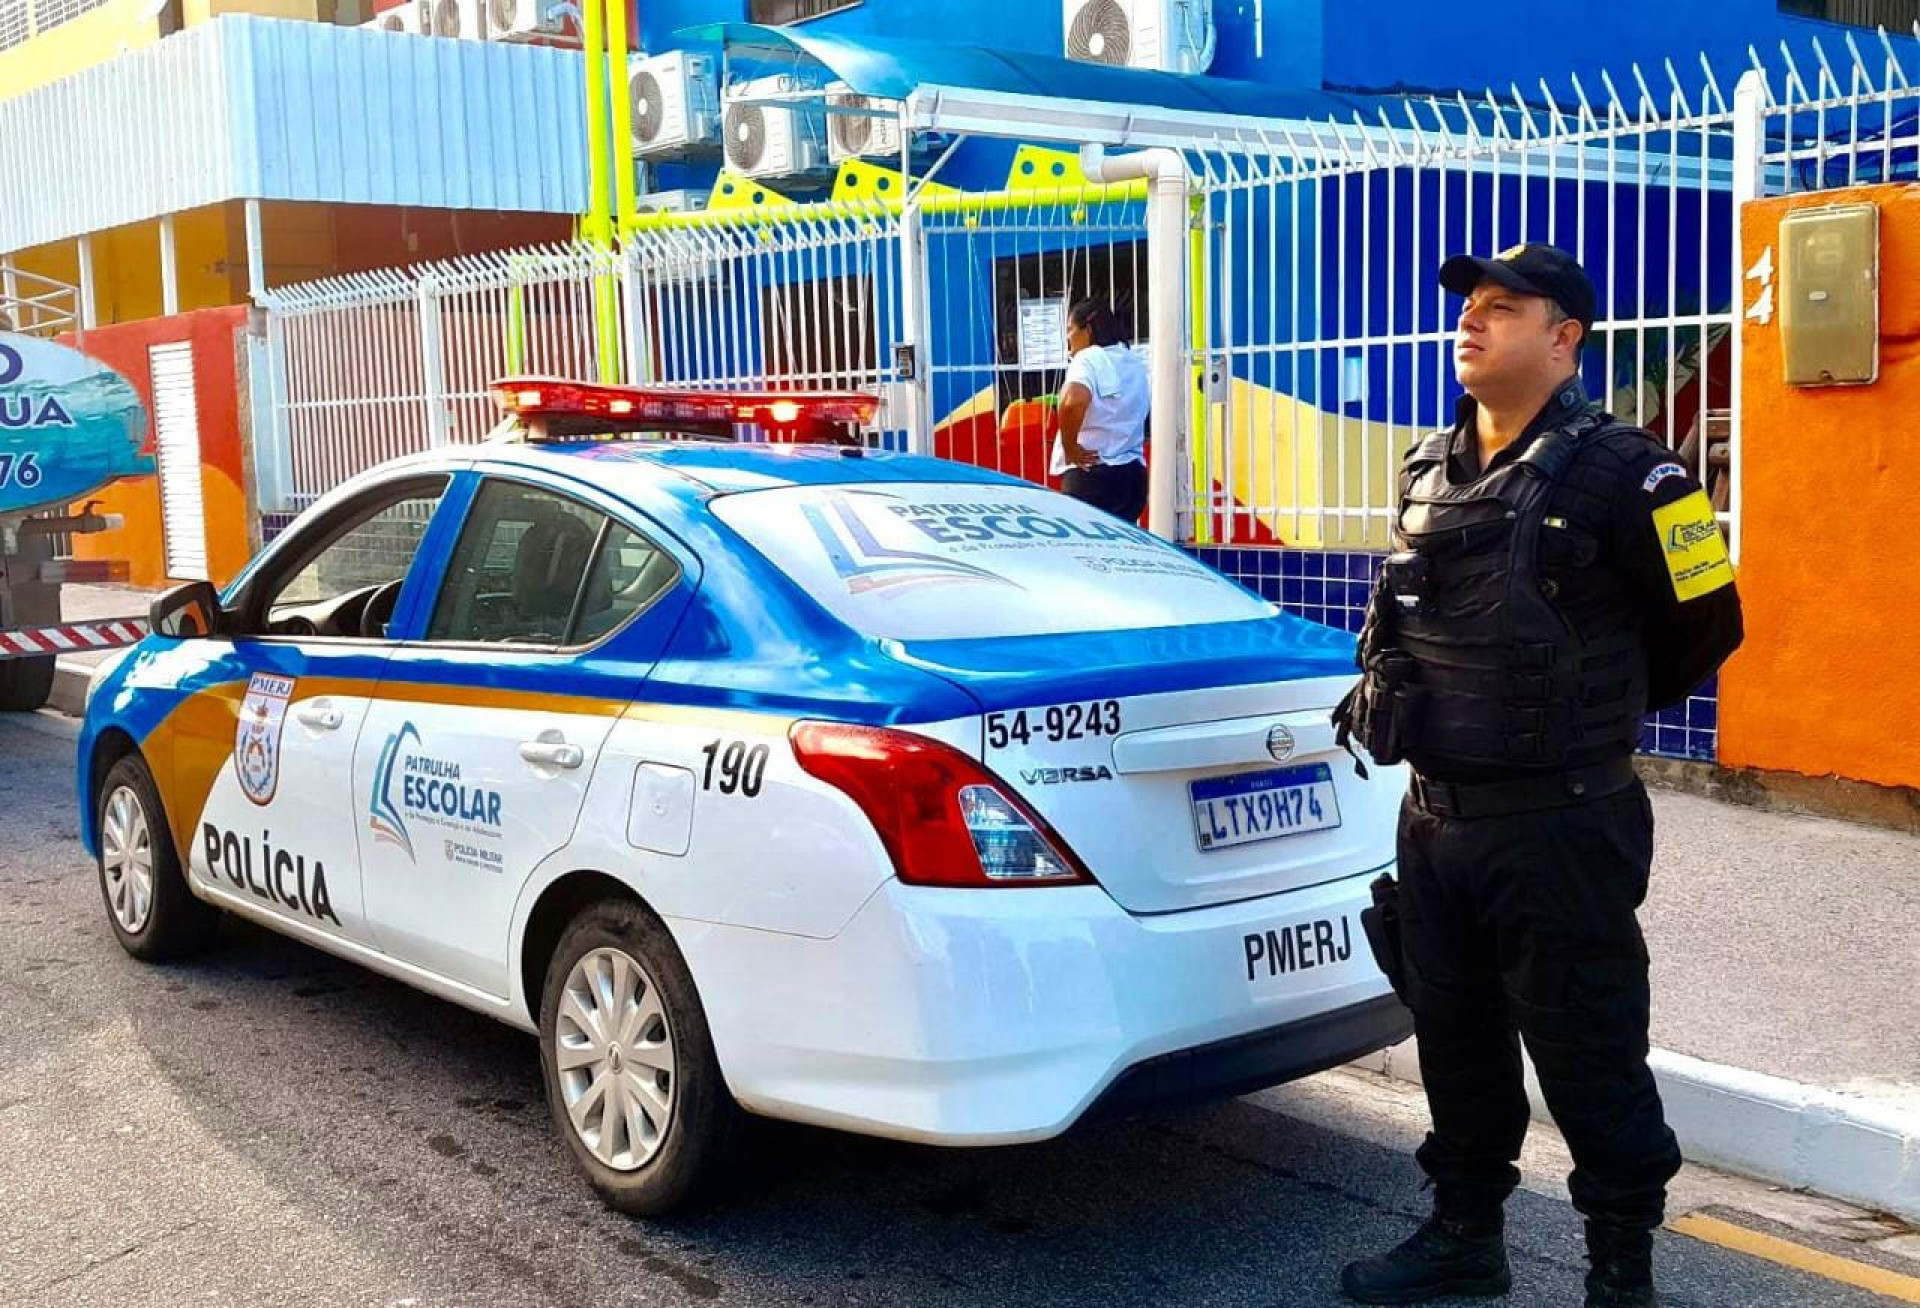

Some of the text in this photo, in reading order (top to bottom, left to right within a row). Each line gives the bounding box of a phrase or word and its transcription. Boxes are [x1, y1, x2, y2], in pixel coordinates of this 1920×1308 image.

[886, 502, 1042, 518] PATRULHA
[251, 677, 292, 696] PMERJ
[987, 700, 1121, 750] 54-9243
[404, 755, 461, 780] PATRULHA
[702, 738, 771, 799] 190
[1019, 764, 1114, 786] VERSA
[404, 774, 502, 827] ESCOLAR
[1207, 786, 1323, 840] LTX9H74
[203, 821, 343, 928] POLÍCIA
[1243, 915, 1352, 982] PMERJ
